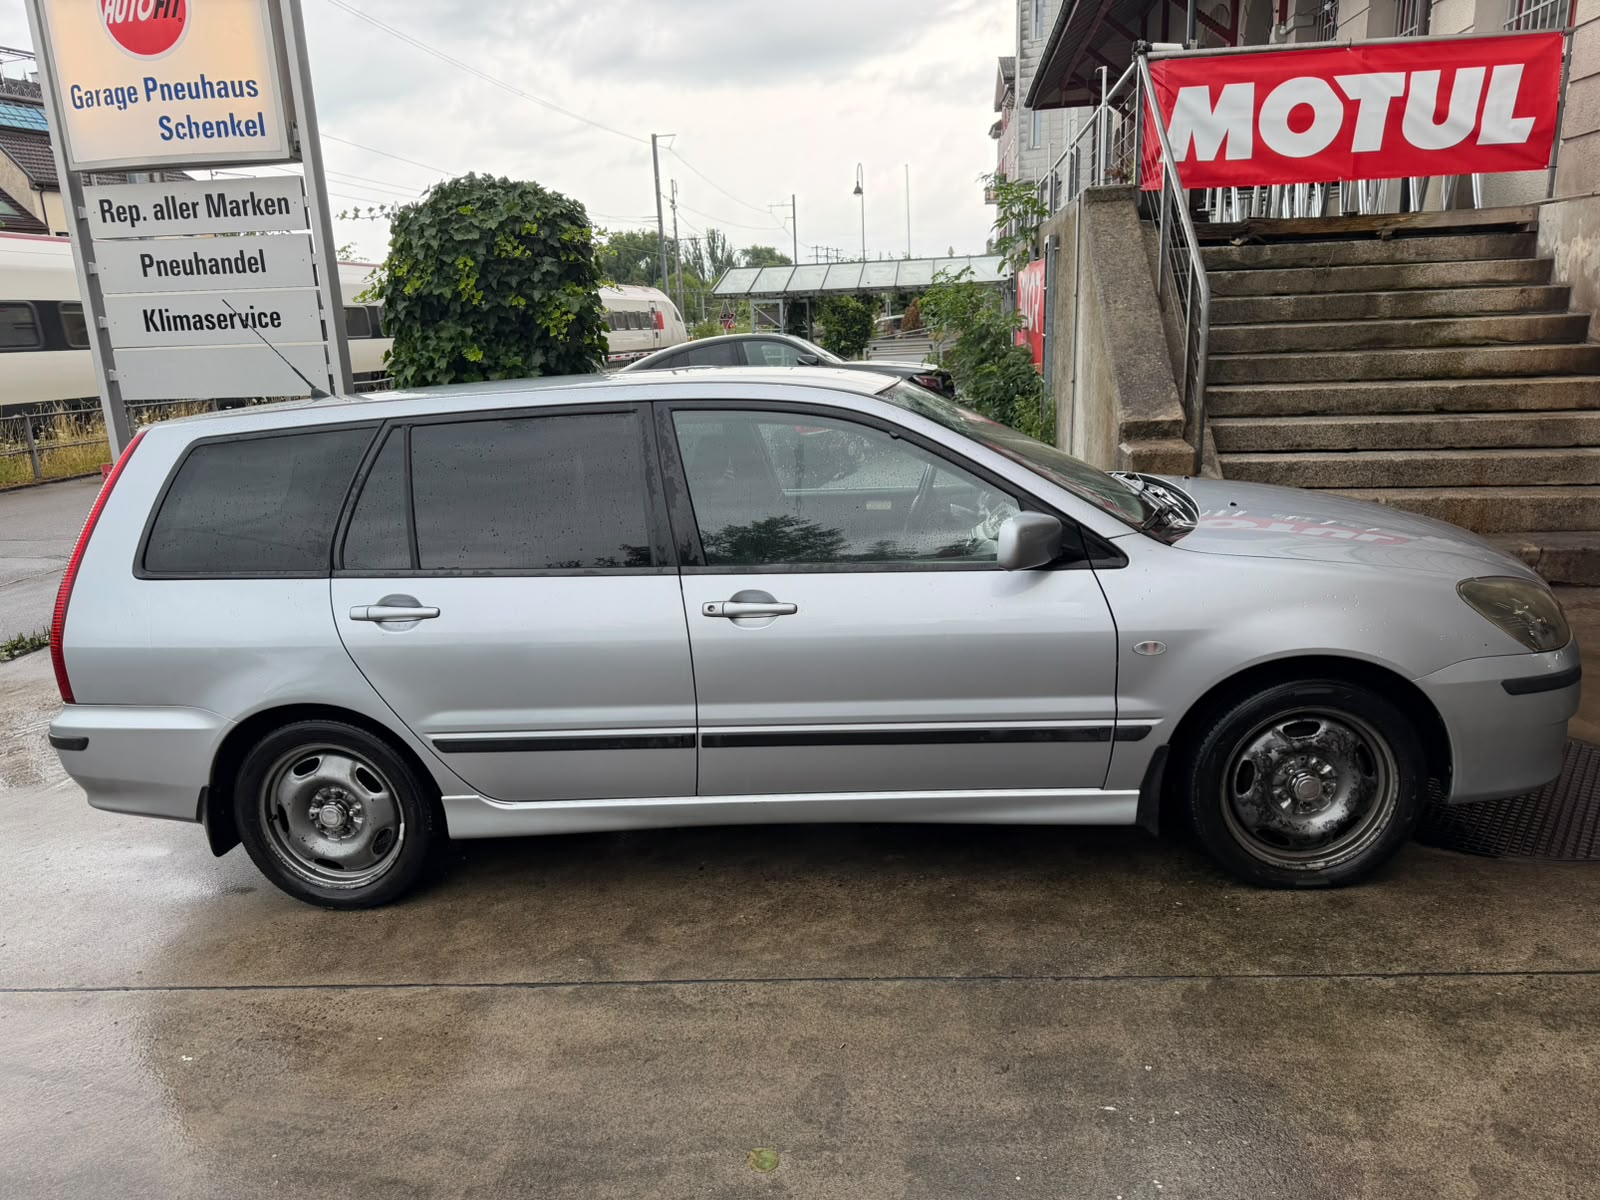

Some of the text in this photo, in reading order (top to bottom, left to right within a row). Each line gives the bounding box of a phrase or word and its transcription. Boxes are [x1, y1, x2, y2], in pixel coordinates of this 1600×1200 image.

[70, 73, 259, 111] Garage Pneuhaus
[158, 111, 266, 141] Schenkel
[1159, 63, 1536, 162] MOTUL
[98, 191, 291, 227] Rep. aller Marken
[139, 249, 267, 278] Pneuhandel
[142, 305, 282, 333] Klimaservice
